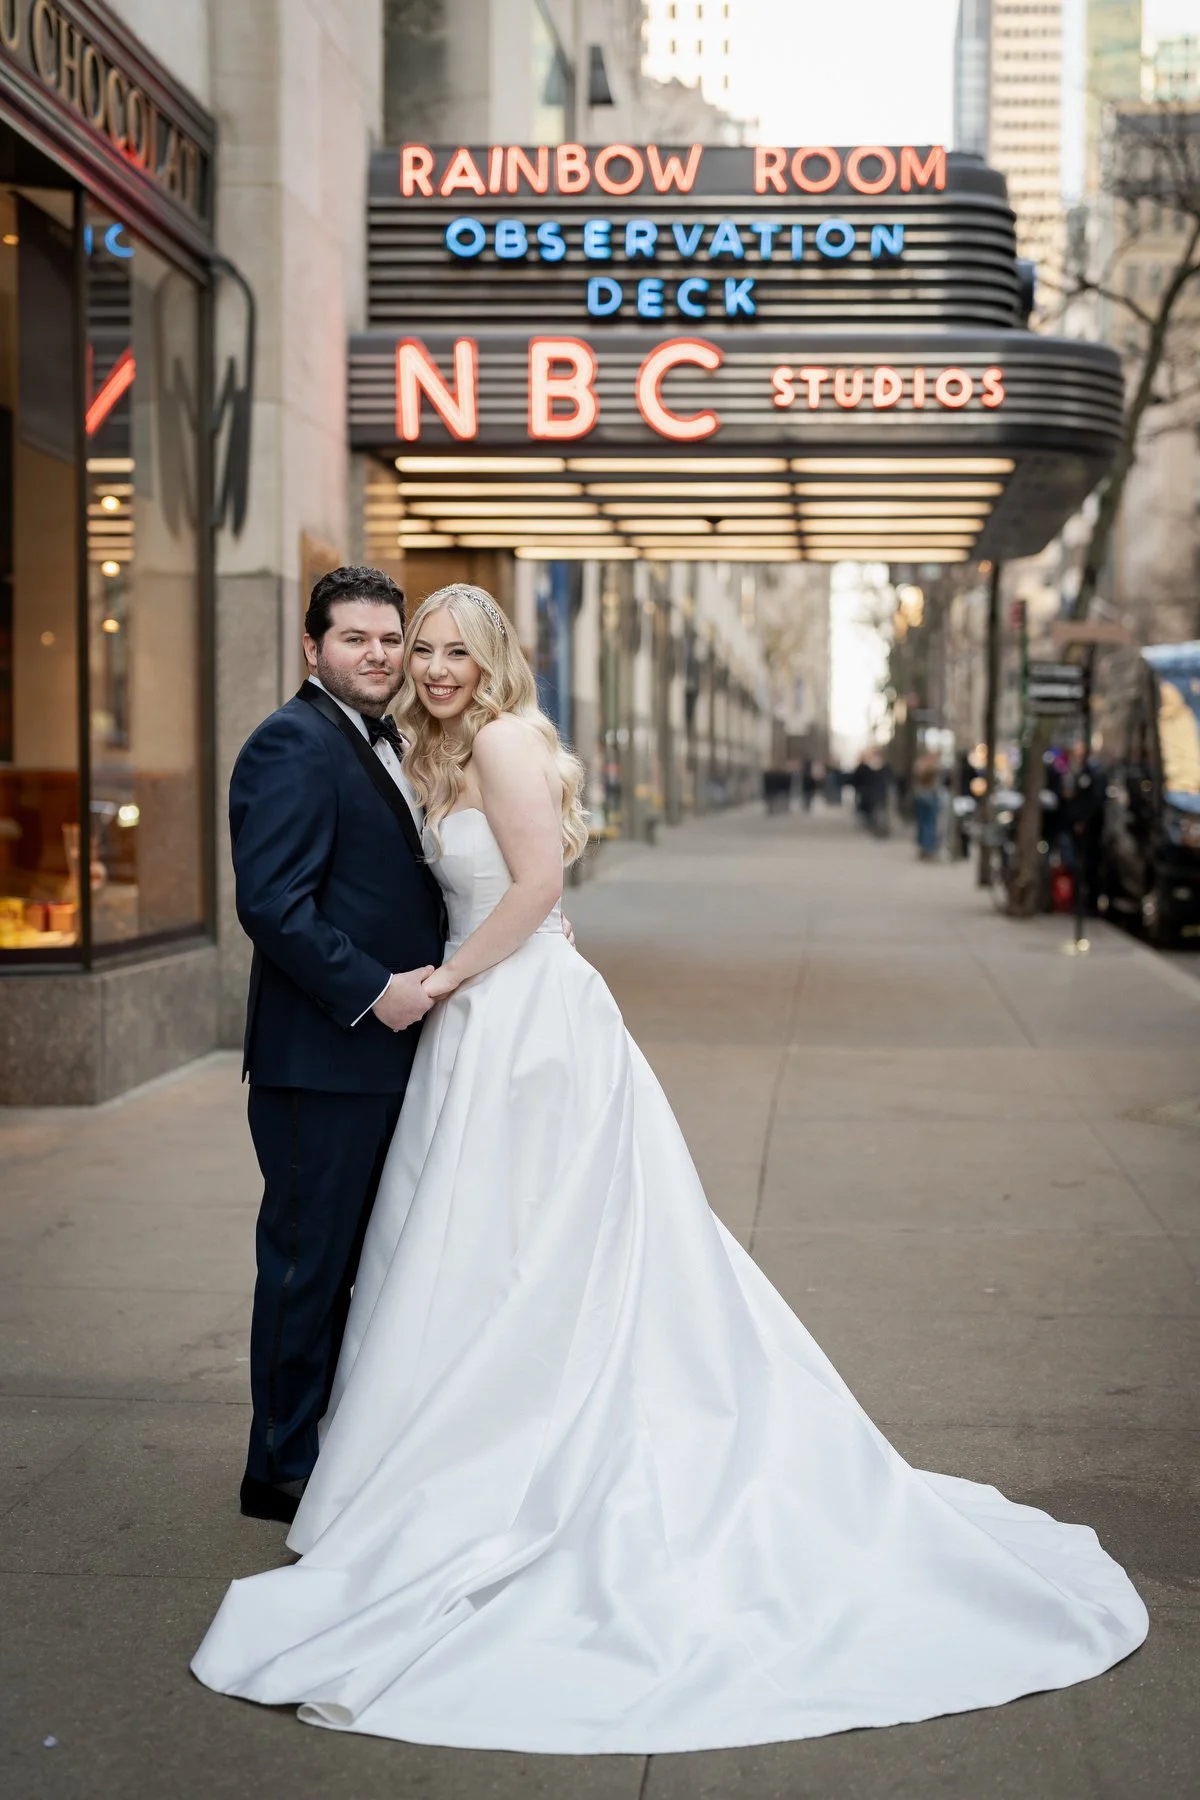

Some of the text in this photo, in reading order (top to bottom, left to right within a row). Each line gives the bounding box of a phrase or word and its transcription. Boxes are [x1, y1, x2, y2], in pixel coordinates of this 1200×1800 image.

[400, 143, 946, 196] RAINBOW ROOM
[446, 217, 903, 260] OBSERVATION
[588, 278, 755, 317] DECK
[395, 336, 1004, 440] NBC STUDIOS
